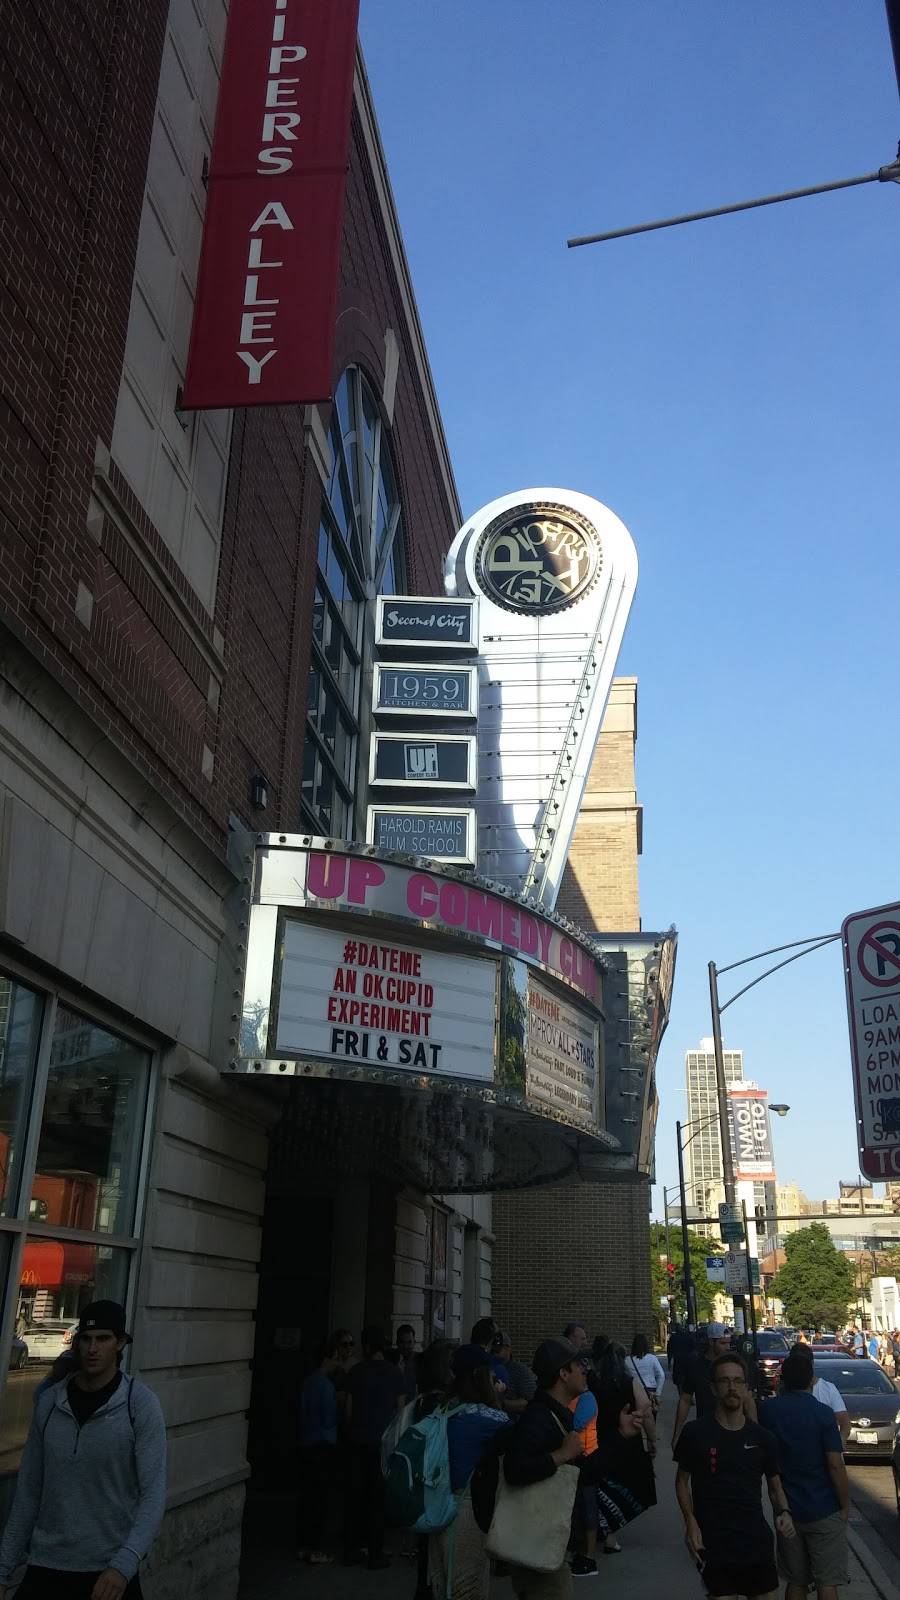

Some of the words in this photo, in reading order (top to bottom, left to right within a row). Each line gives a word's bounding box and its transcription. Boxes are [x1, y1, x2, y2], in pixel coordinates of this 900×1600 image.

[257, 0, 307, 175] IPERS
[236, 202, 294, 384] ALLEY
[387, 611, 436, 627] Second
[437, 614, 467, 636] City
[388, 676, 459, 700] 1959
[379, 836, 406, 850] FILM
[412, 837, 461, 853] SCHOOL
[380, 818, 426, 833] HAROLD
[428, 819, 462, 835] RAMIS
[308, 853, 385, 904] UP
[407, 874, 554, 964] COMEDY
[344, 940, 422, 977] #DATEME
[333, 968, 357, 994] AN
[328, 997, 432, 1036] EXPERIMENT
[862, 1004, 900, 1026] LOA
[331, 1028, 369, 1057] FRI
[377, 1036, 388, 1060] &
[399, 1039, 442, 1068] SAT
[736, 1100, 754, 1159] TOWN
[751, 1103, 767, 1141] OLD
